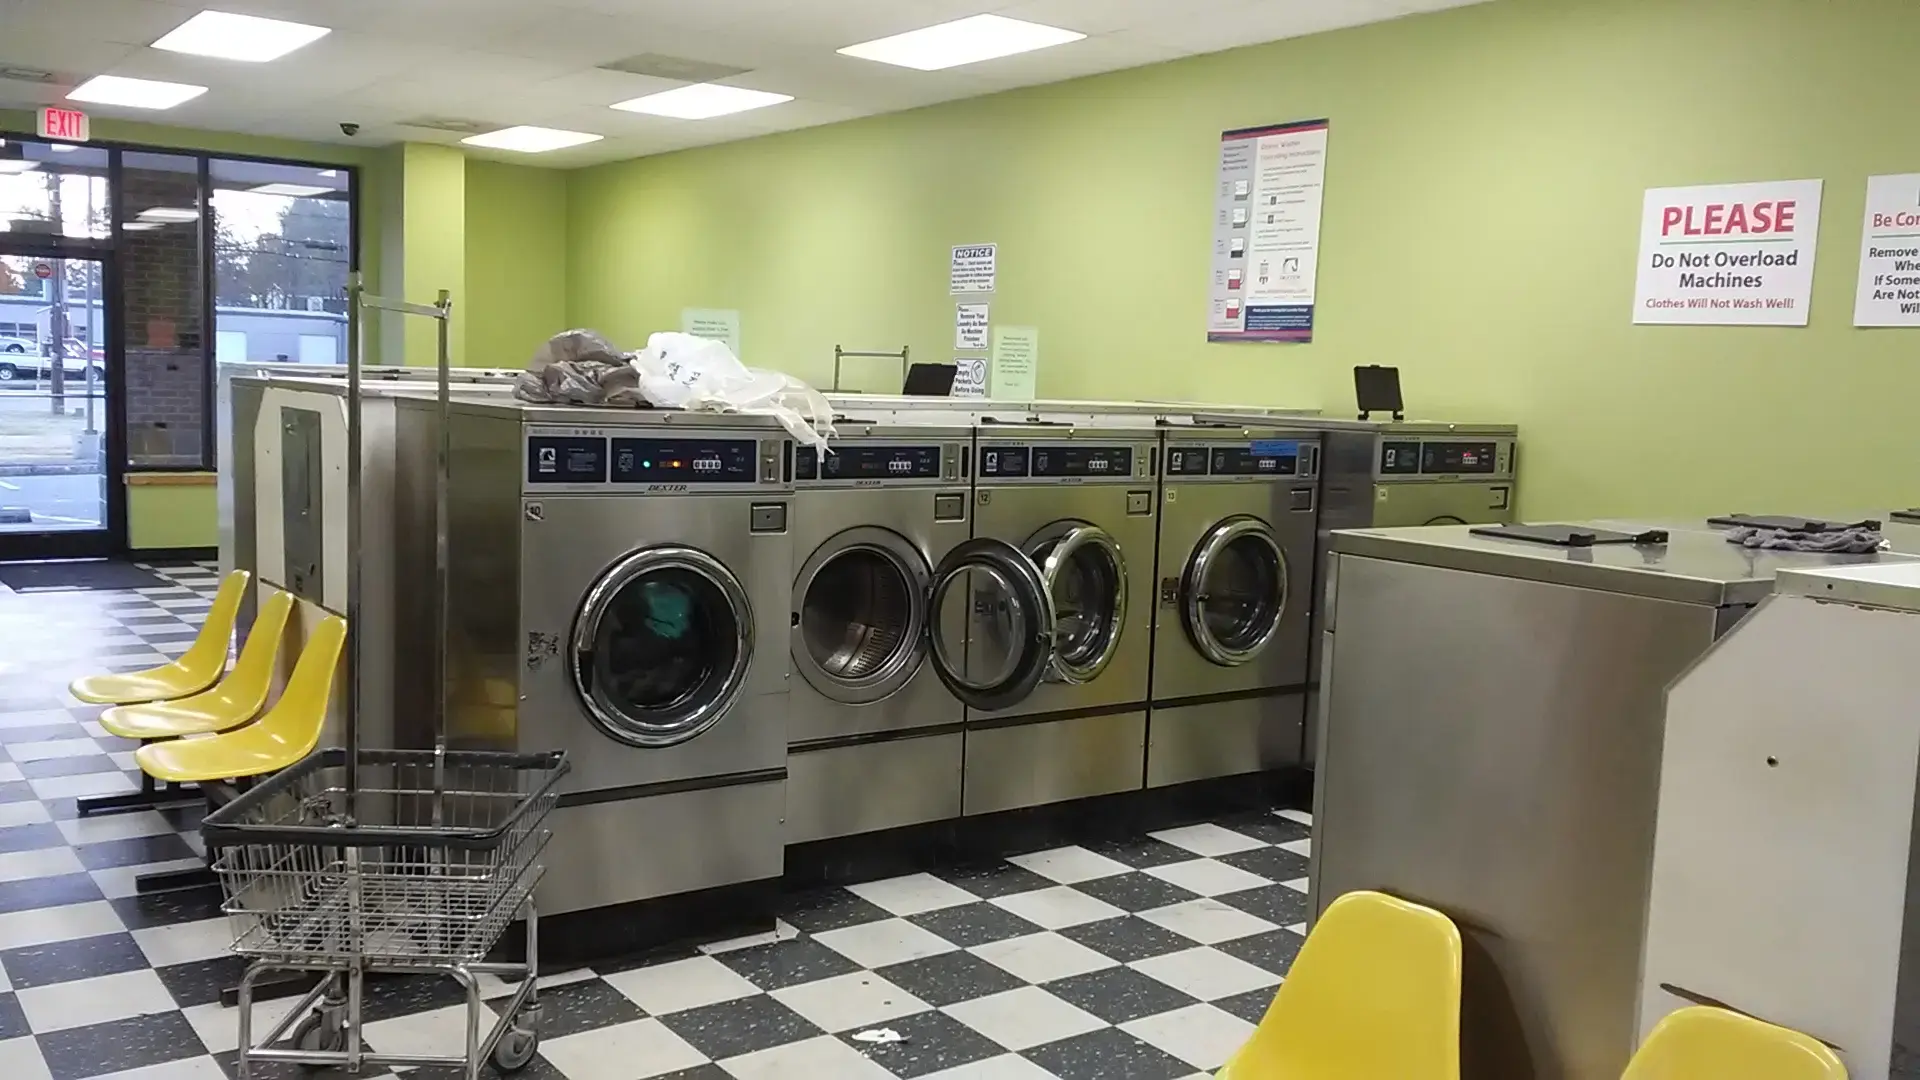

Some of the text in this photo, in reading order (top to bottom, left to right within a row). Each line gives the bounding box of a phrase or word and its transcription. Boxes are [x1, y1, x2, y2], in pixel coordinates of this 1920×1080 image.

[46, 109, 83, 138] EXIT
[1661, 201, 1796, 236] PLEASE
[1873, 213, 1892, 227] Be
[957, 249, 991, 257] NOTICE
[1869, 247, 1918, 257] Remove
[1652, 249, 1798, 268] Do Not Overload
[1679, 272, 1763, 288] Machines
[1874, 275, 1884, 285] If
[1873, 289, 1895, 299] Are
[1646, 298, 1794, 308] Clothes Will Not Wash Well!
